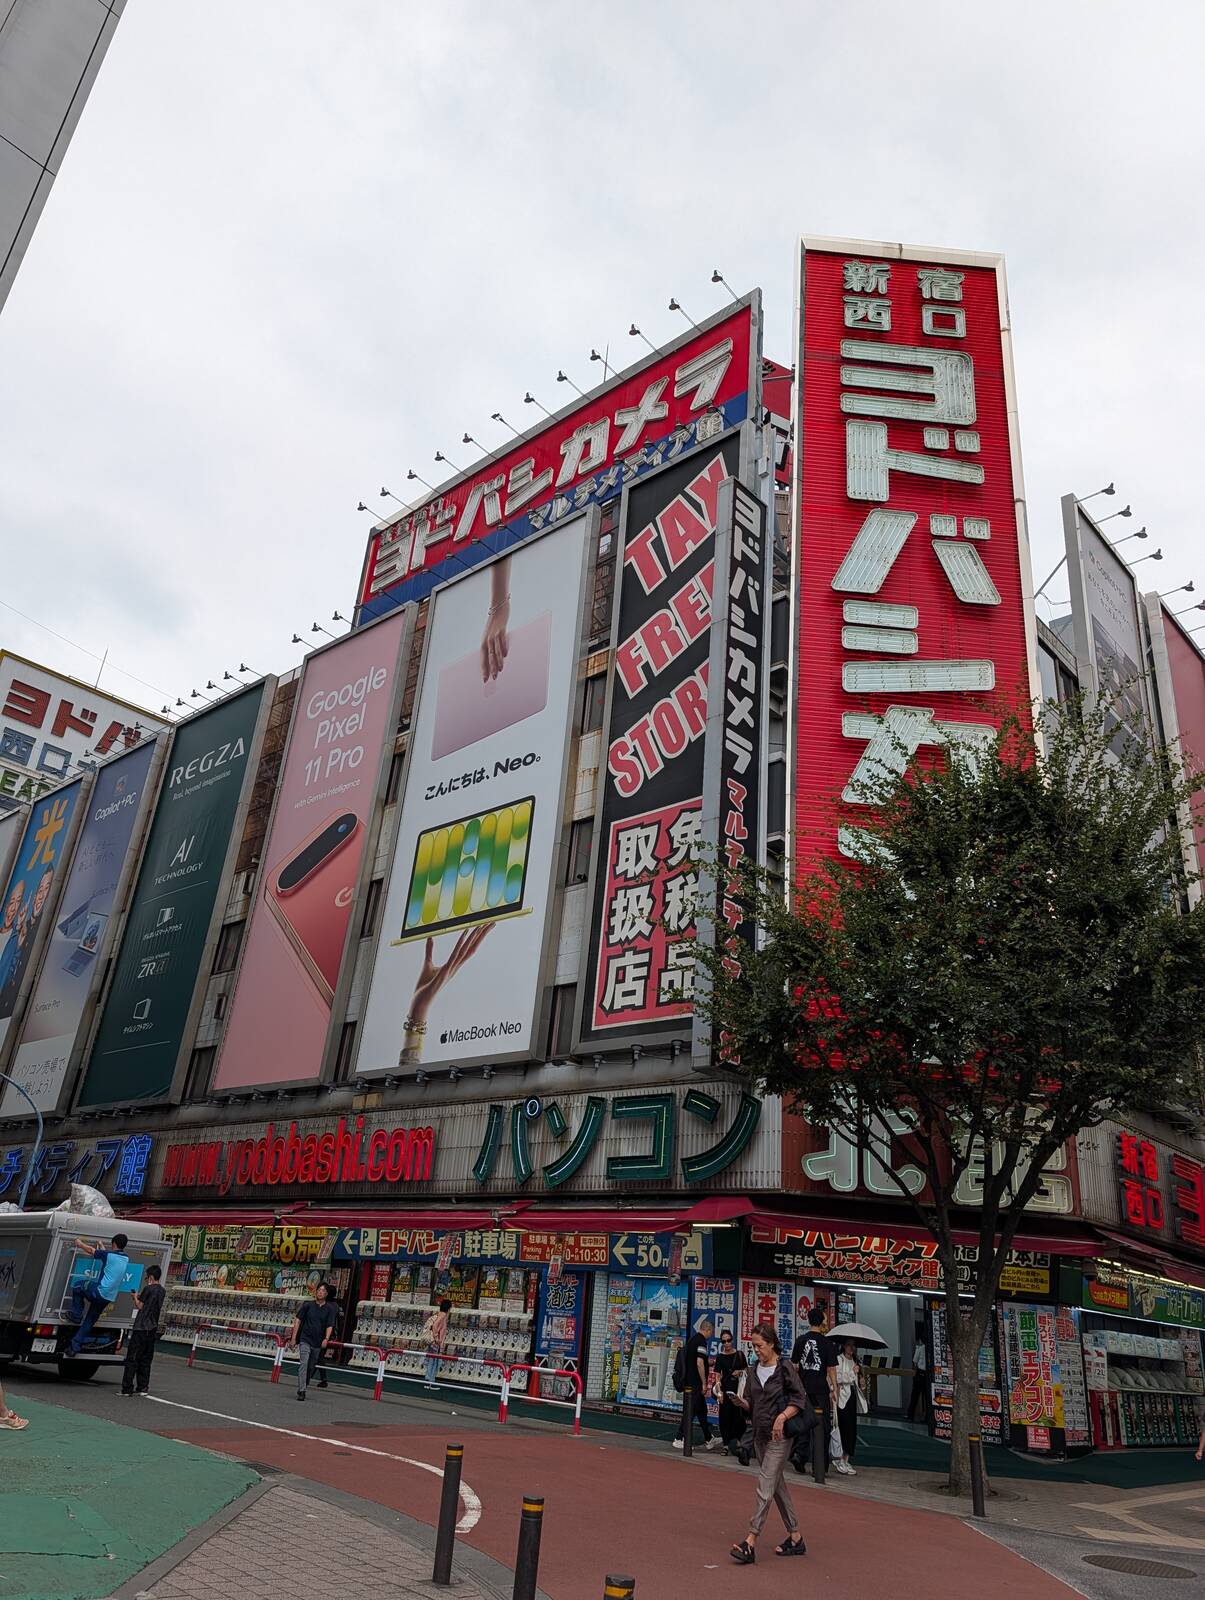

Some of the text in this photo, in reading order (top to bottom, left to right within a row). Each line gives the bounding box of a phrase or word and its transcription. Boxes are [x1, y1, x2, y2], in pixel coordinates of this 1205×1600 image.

[842, 259, 965, 302] 新宿
[842, 295, 967, 338] 西口
[370, 337, 733, 593] ヨドバシカメラ
[615, 557, 715, 700] FRE
[725, 488, 761, 774] ヨドバシカメラ
[2, 679, 141, 754] ヨドバ
[307, 666, 387, 719] Google
[315, 702, 366, 749] Pixel
[608, 657, 710, 798] STOR
[0, 727, 97, 779] 西口
[169, 737, 244, 788] REGZA
[304, 746, 364, 786] 11 Pro
[153, 862, 204, 886] TECHNOLOGY
[170, 835, 195, 867] AI
[602, 823, 659, 1011] 取扱店
[447, 1020, 522, 1044] MacBook Neo
[163, 1115, 435, 1196] www.yodobashi.com
[472, 1088, 762, 1190] パソコン
[579, 1248, 606, 1262] 10:30
[815, 1250, 940, 1279] マルチメディア館
[694, 1293, 734, 1311] 駐車場
[758, 1283, 777, 1294] 最短
[718, 1316, 724, 1327] P
[1019, 1310, 1043, 1422] 節電エアコン
